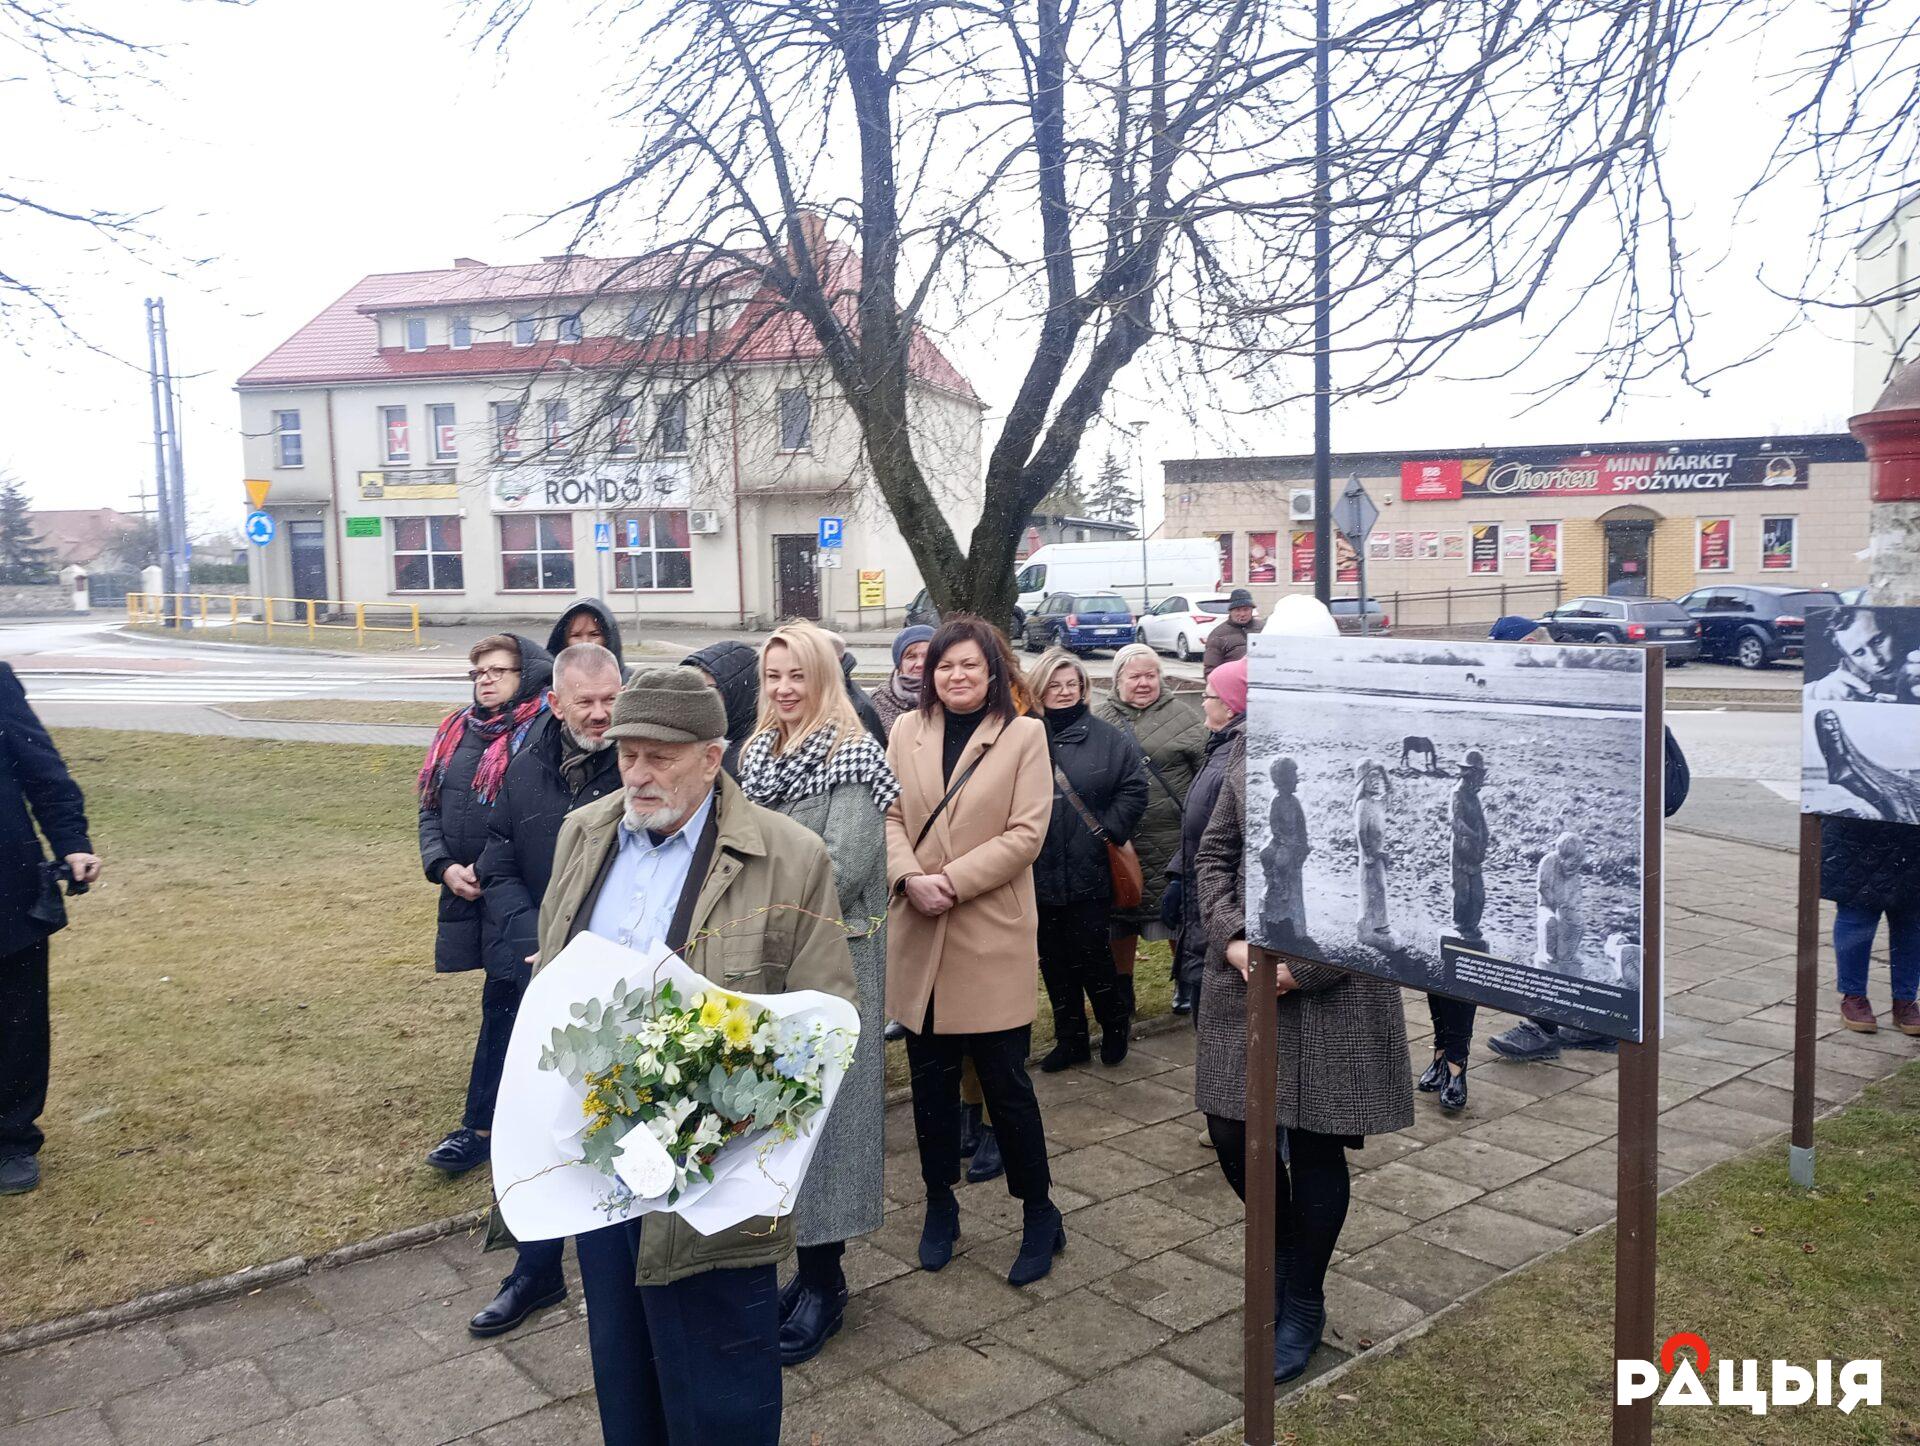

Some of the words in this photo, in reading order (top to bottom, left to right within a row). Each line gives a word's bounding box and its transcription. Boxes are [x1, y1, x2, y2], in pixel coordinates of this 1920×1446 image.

[1604, 458, 1652, 472] MINI
[1654, 453, 1738, 471] MARKET
[1487, 462, 1599, 493] Chorten
[1611, 471, 1730, 491] SPOŻYWCZY
[823, 520, 839, 540] P
